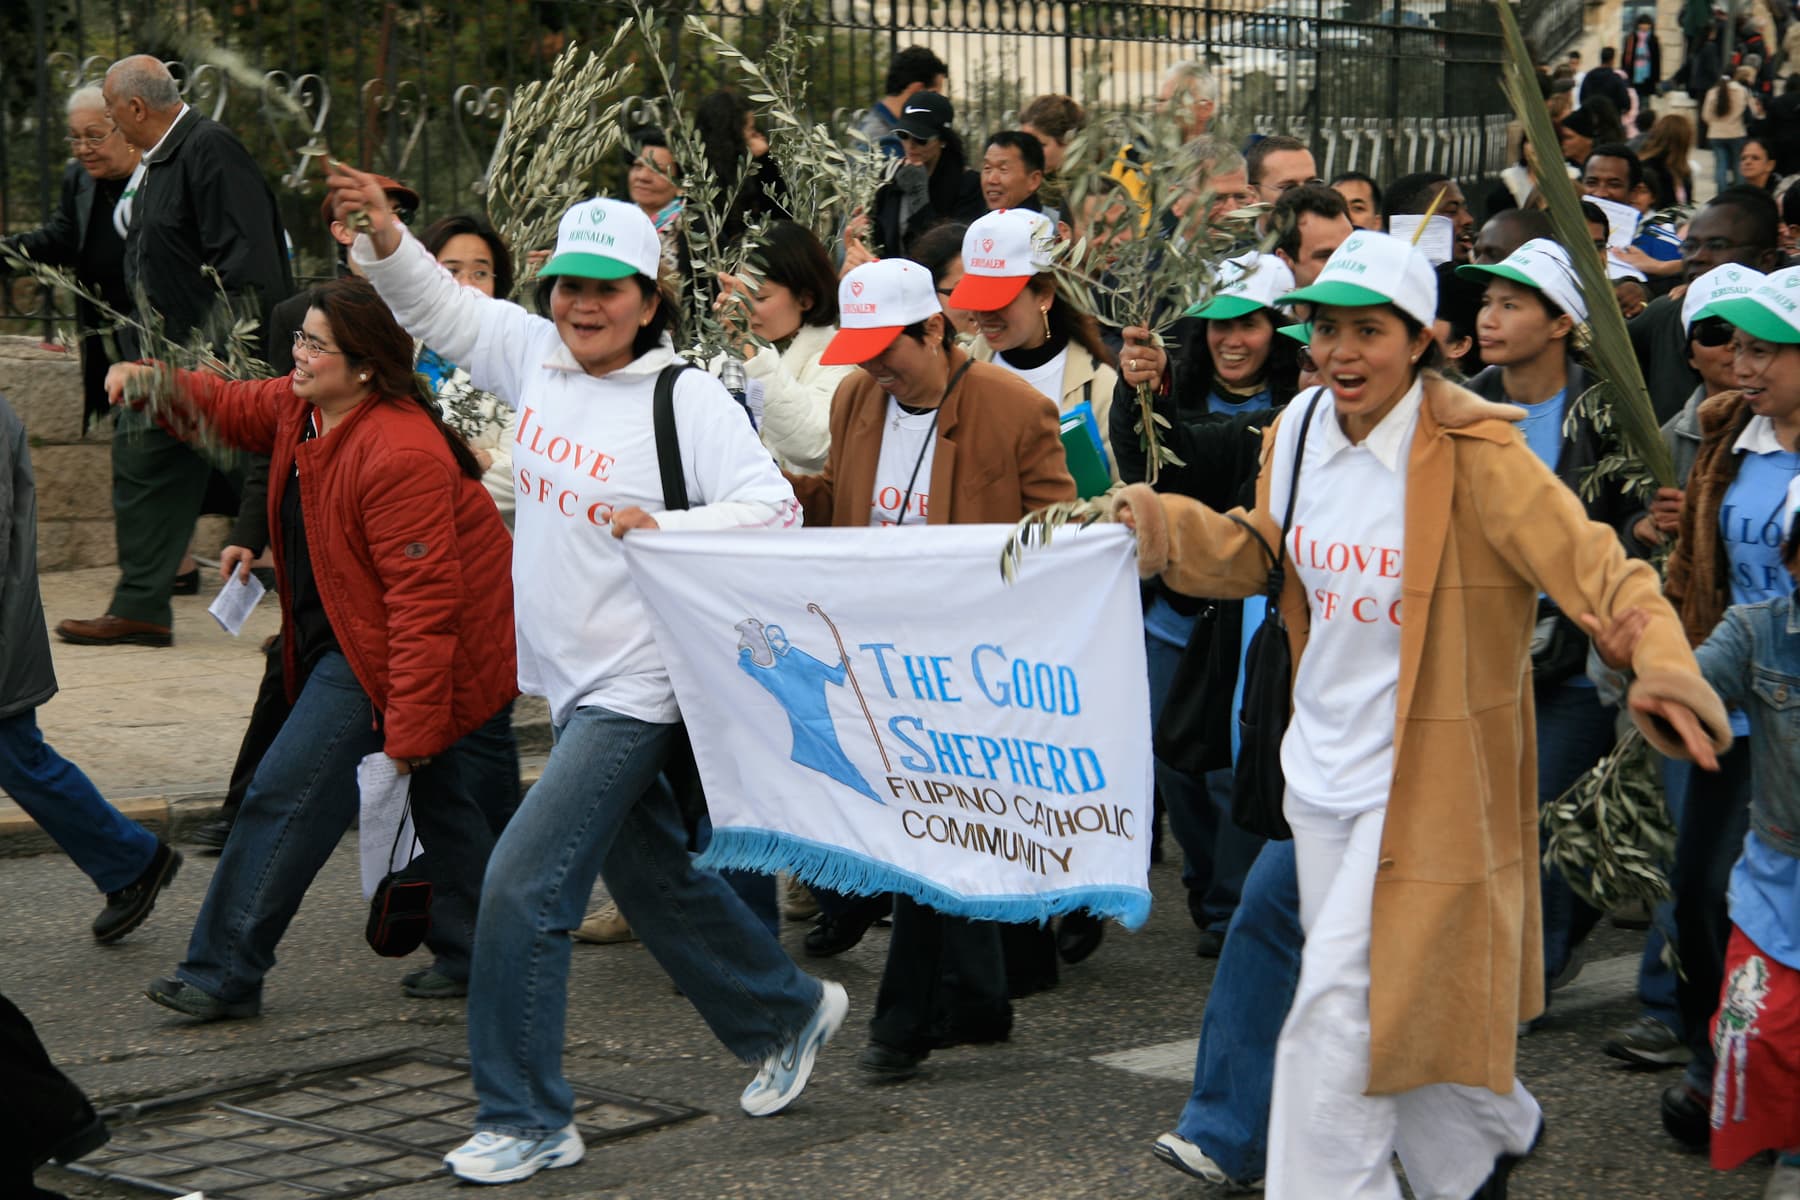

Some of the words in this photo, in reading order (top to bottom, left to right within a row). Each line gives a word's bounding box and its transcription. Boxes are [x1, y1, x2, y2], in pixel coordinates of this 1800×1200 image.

[568, 229, 615, 247] JERUSALEM
[515, 406, 536, 446] I
[529, 424, 616, 483] LOVE
[1294, 524, 1305, 567] I
[1309, 538, 1402, 579] LOVE
[1722, 505, 1737, 542] I
[858, 643, 963, 702] THE
[971, 643, 1082, 717] GOOD
[888, 715, 1108, 796] SHEPHERD
[886, 776, 1008, 816] FILIPINO
[1013, 794, 1137, 841] CATHOLIC
[901, 809, 1074, 876] COMMUNITY
